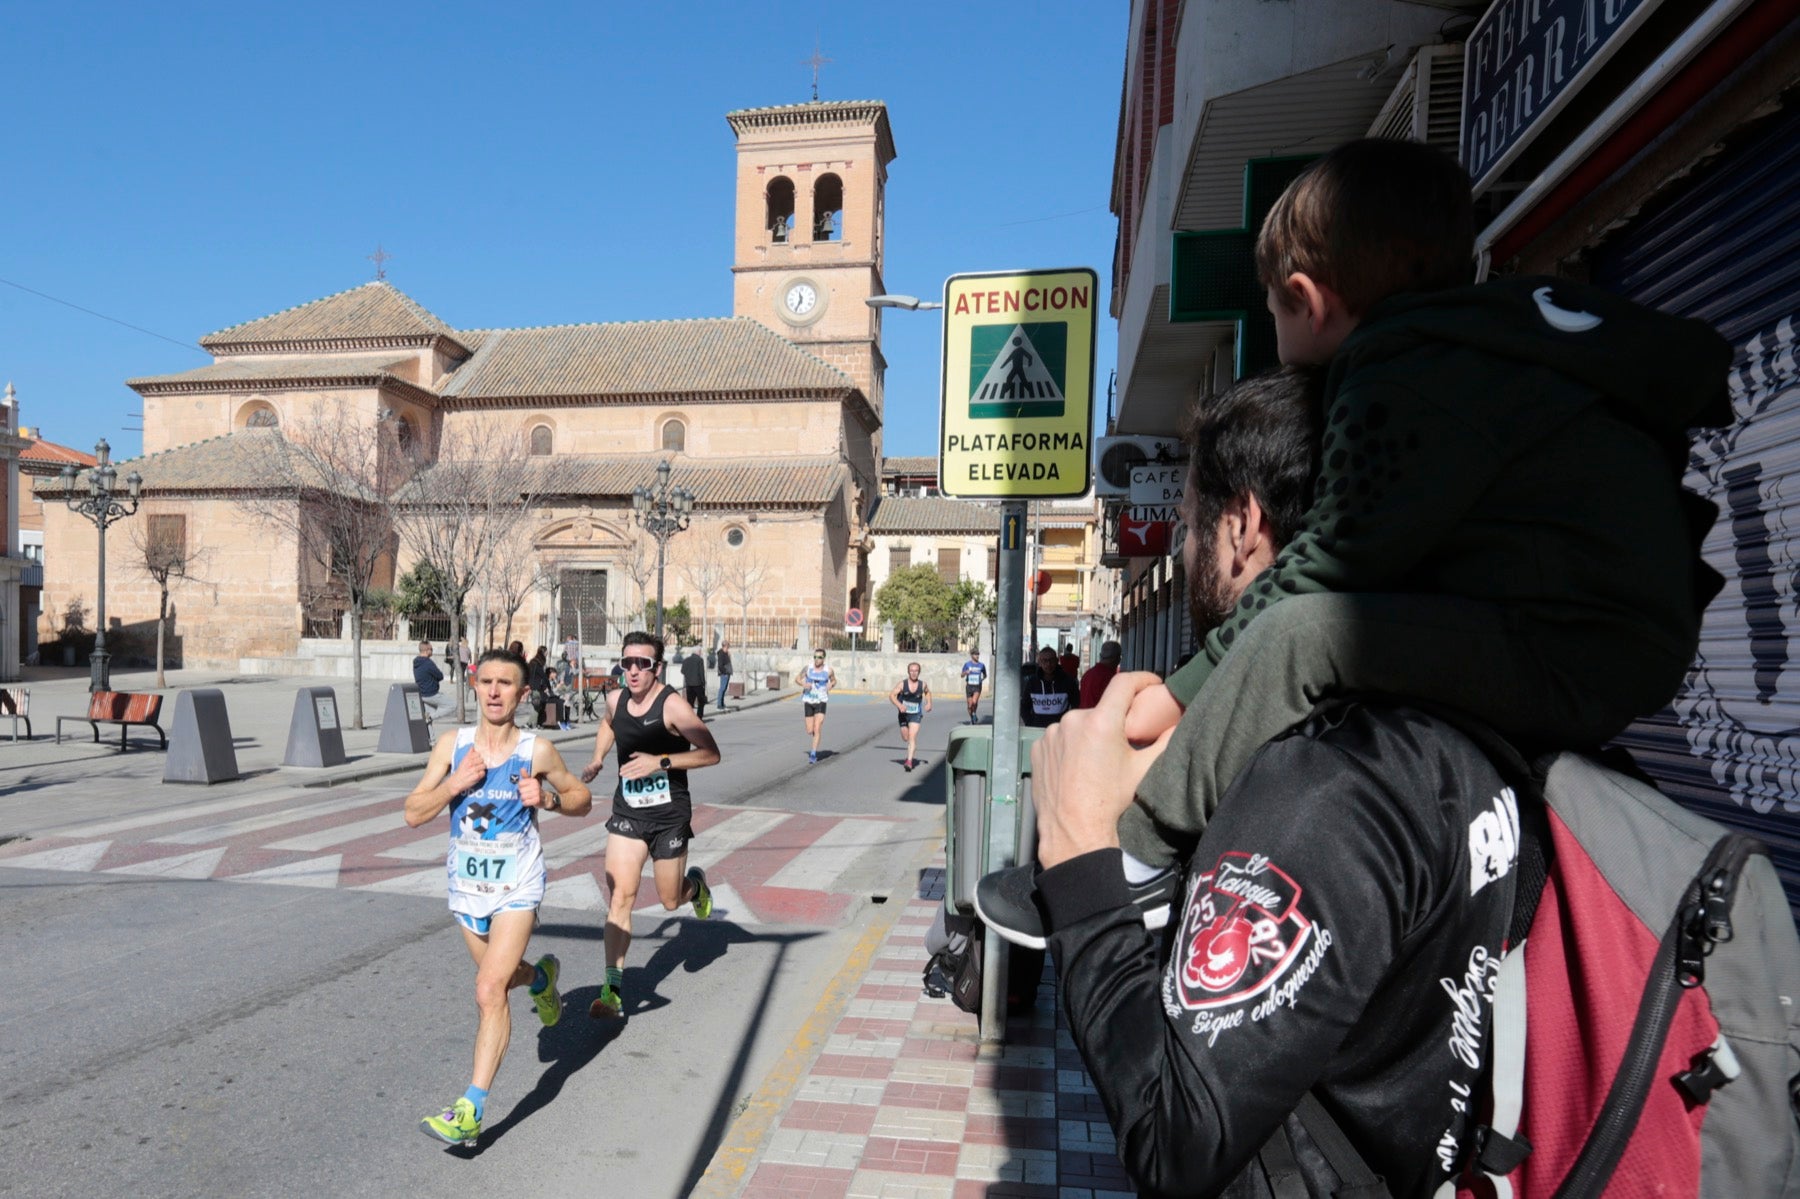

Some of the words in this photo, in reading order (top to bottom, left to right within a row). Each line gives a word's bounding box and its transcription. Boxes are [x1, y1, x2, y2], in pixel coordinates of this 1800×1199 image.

[954, 285, 1089, 316] ATENCION
[948, 432, 1084, 452] PLATAFORMA
[968, 462, 1060, 481] ELEVADA
[1133, 468, 1180, 484] CAFÉ
[1162, 488, 1184, 500] BA
[1032, 697, 1063, 706] Reebok
[625, 775, 666, 794] 1030
[466, 856, 506, 879] 617
[1244, 852, 1270, 877] El
[1214, 861, 1282, 909] Tanque
[1189, 892, 1217, 935] 25
[1191, 1007, 1245, 1049] Sigue
